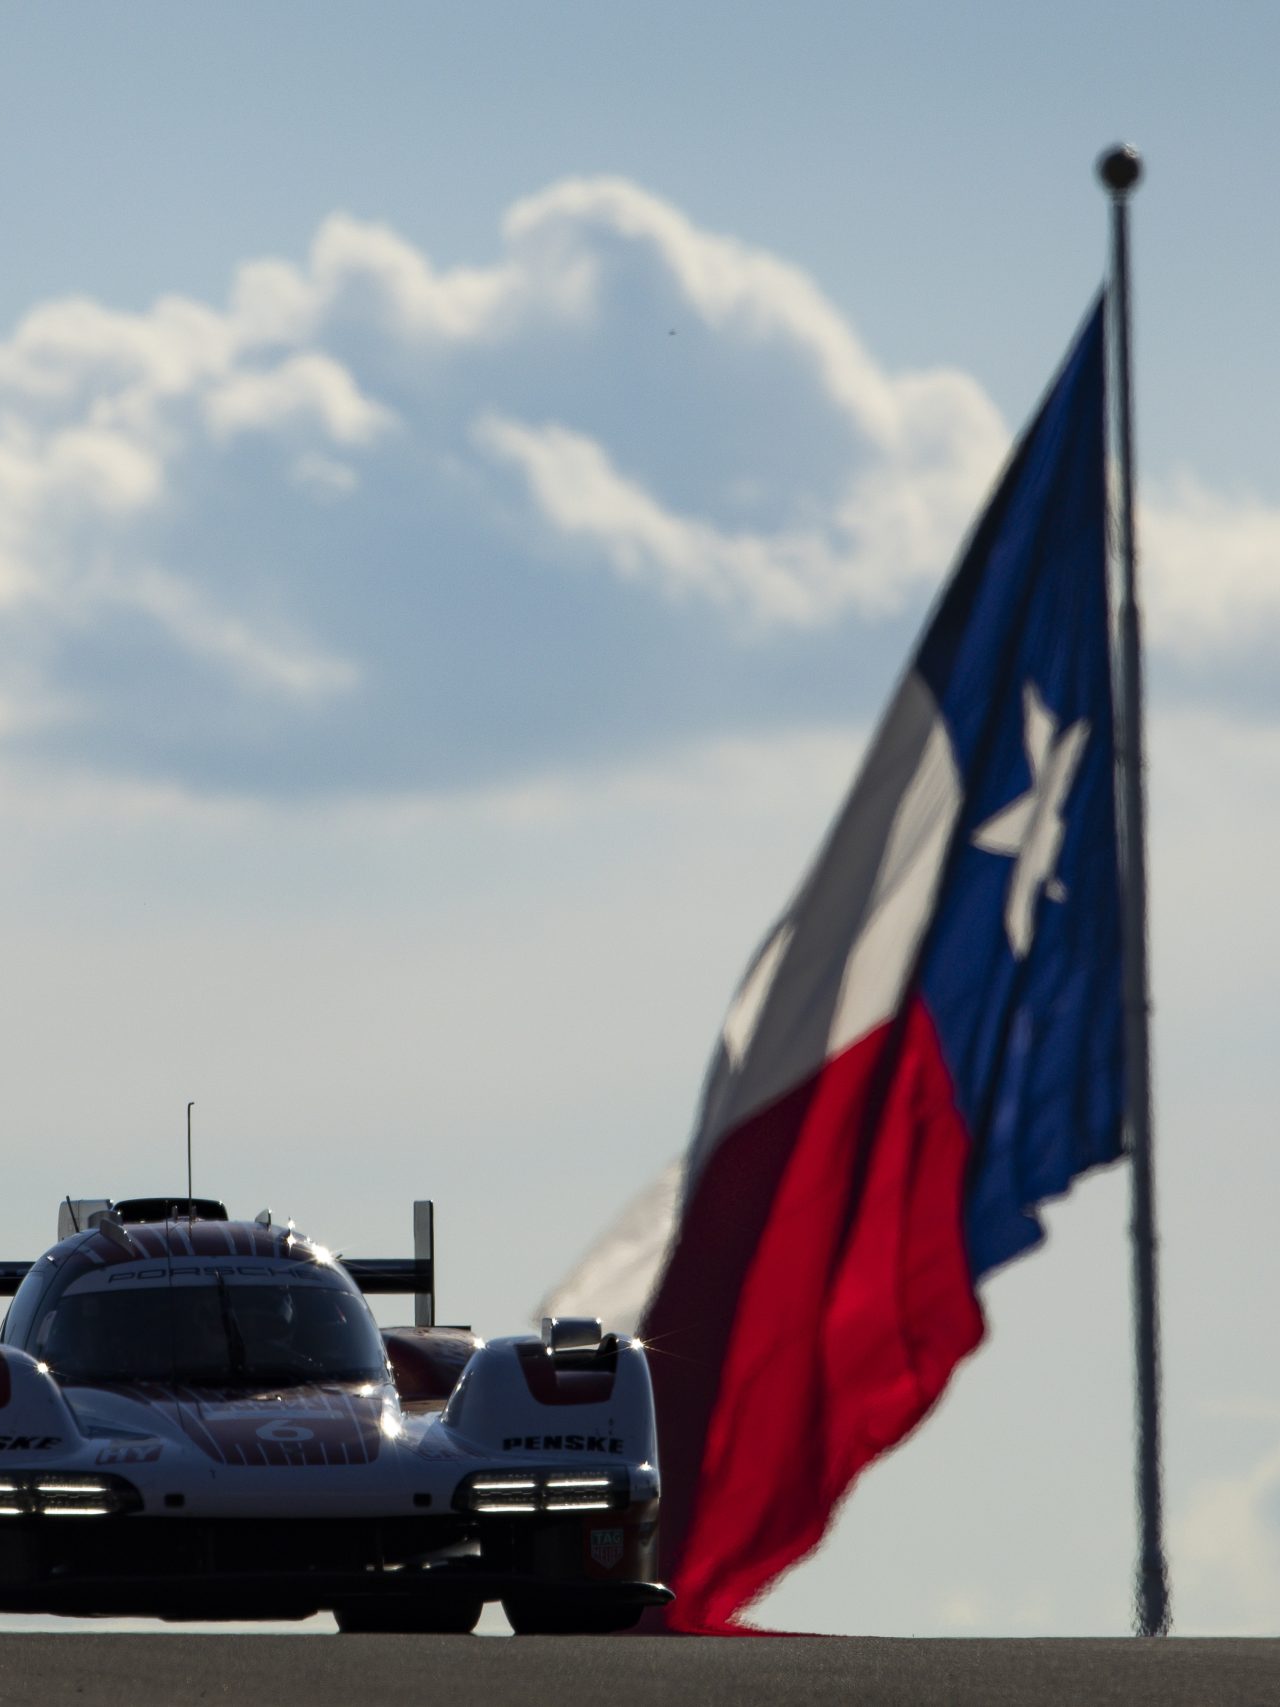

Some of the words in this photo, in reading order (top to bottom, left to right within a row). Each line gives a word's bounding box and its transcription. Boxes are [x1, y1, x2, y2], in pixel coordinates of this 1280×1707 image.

[108, 1266, 322, 1283] PORSCHE
[255, 1419, 315, 1442] 6
[502, 1435, 624, 1454] PENSKE
[593, 1532, 623, 1545] TAG
